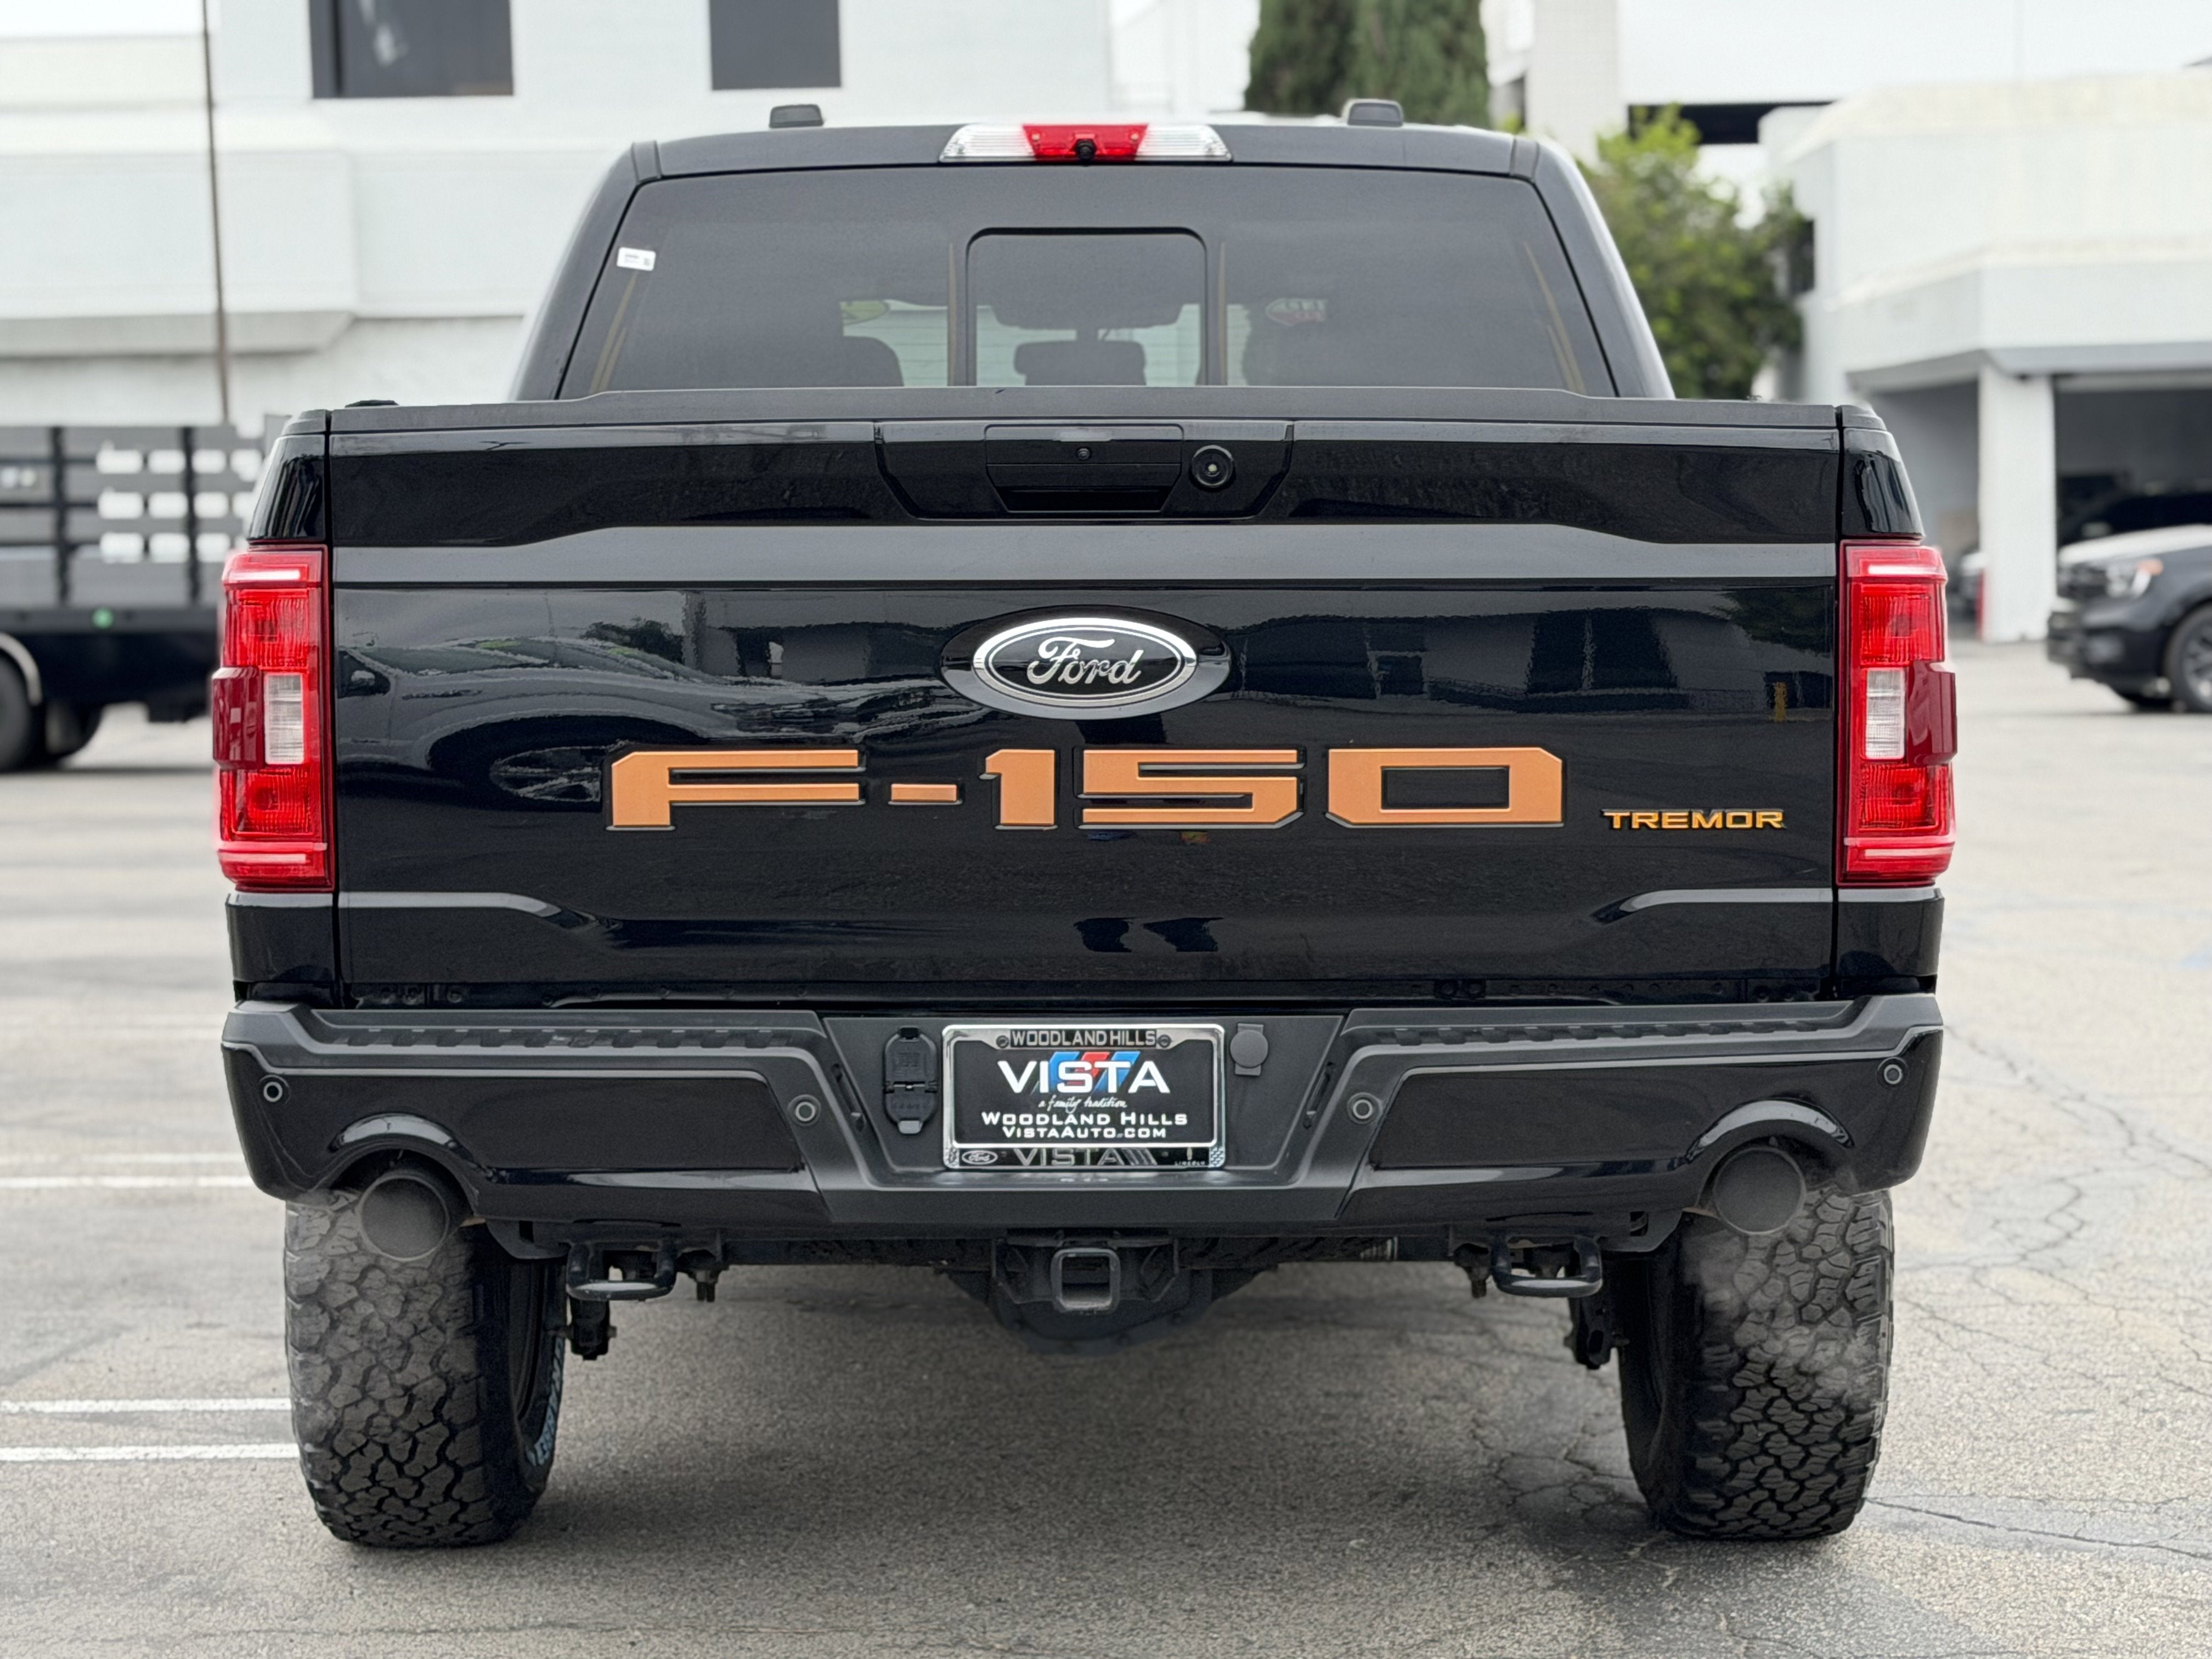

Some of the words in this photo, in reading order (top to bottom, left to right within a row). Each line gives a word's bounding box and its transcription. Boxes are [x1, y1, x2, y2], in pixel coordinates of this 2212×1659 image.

[1026, 636, 1144, 684] Ford
[611, 747, 1563, 827] F-150
[1602, 809, 1784, 829] TREMOR
[1012, 1030, 1107, 1046] WOODLAND
[1110, 1030, 1156, 1046] HILLS
[997, 1060, 1171, 1093] VISTA
[1084, 1096, 1127, 1108] tradition
[981, 1111, 1111, 1125] WOODLAND
[1120, 1111, 1188, 1125] HILLS
[1014, 1148, 1125, 1166] VISTA
